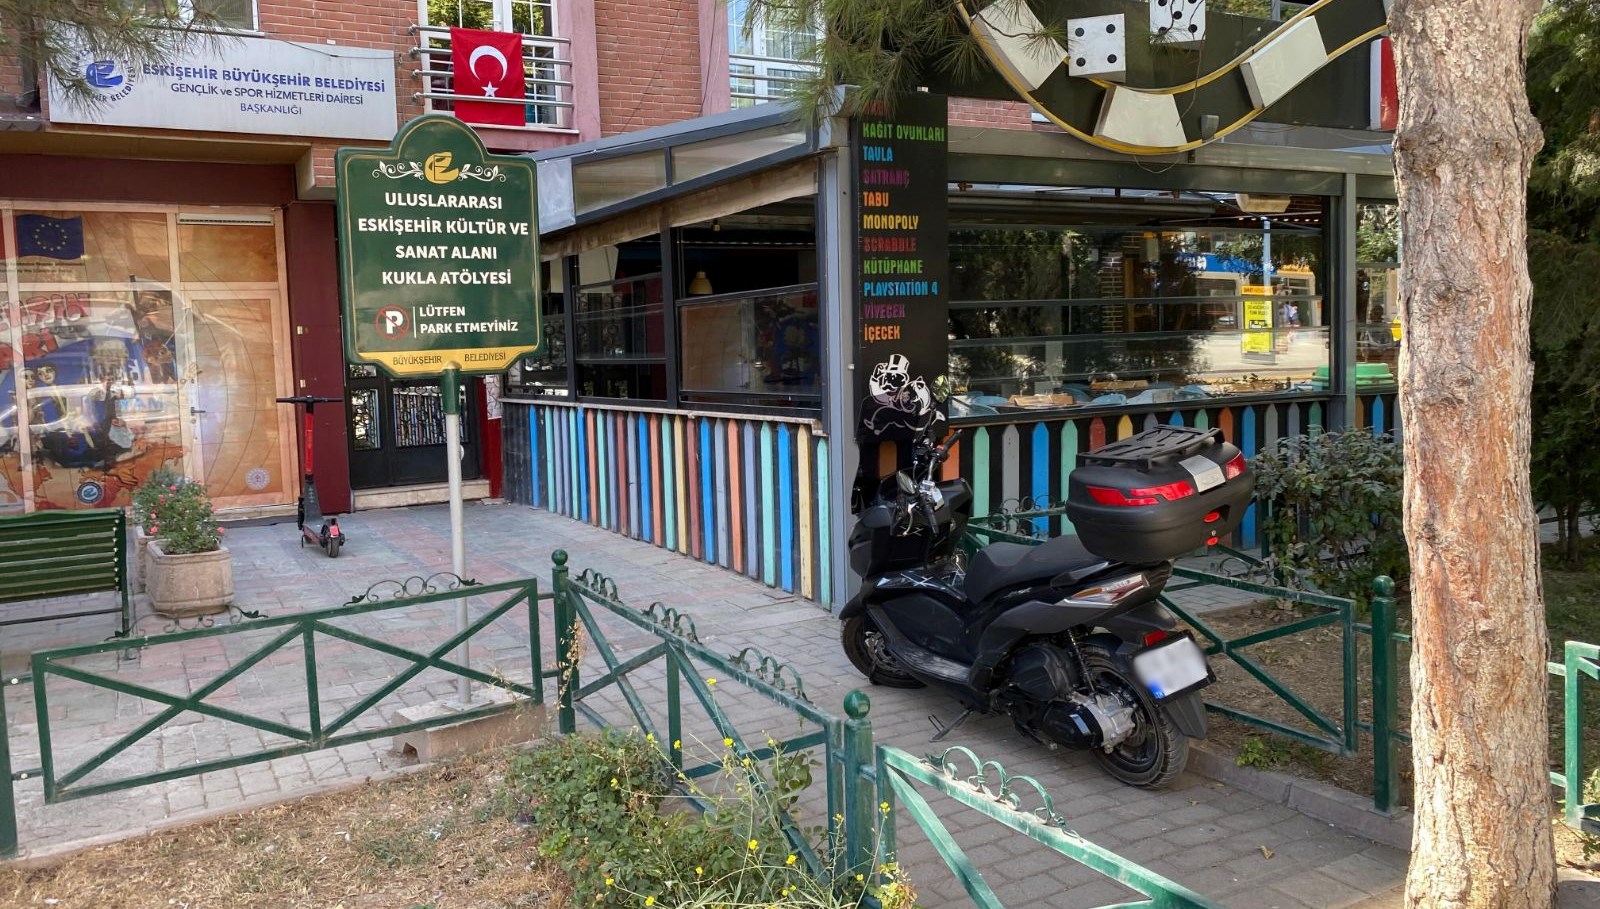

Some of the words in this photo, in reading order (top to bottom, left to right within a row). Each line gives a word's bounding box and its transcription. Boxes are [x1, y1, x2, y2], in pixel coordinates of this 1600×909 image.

[143, 63, 218, 80] ESKİŞEHİR
[222, 68, 311, 87] BÜYÜKŞEHİR
[315, 77, 385, 92] BELEDİYESİ
[171, 83, 218, 96] GENÇLİK
[234, 88, 263, 98] SPOR
[265, 88, 324, 102] HİZMETLERİ
[326, 93, 363, 105] DAİRESİ
[240, 103, 302, 115] BAŞKANLIĞI
[863, 121, 893, 139] KAĞIT
[896, 124, 945, 142] OYUNLARI
[863, 146, 893, 162] TAVLA
[864, 169, 910, 189] SATRANÇ
[385, 192, 502, 209] ULUSLARARASI
[863, 192, 889, 207] TABU
[358, 216, 442, 235] ESKİŞEHİR
[446, 218, 506, 235] KÜLTÜR
[509, 223, 529, 235] VE
[863, 214, 919, 230] MONOPOLY
[395, 245, 448, 258] SANAT
[451, 246, 497, 259] ALANI
[863, 237, 917, 252] SCRABBLE
[863, 257, 923, 274] KÜTÜPHANE
[382, 271, 436, 284] KUKLA
[440, 269, 512, 285] ATÖLYESİ
[931, 281, 938, 296] 4
[419, 305, 466, 317] LÜTFEN
[420, 323, 453, 334] PARK
[455, 319, 519, 333] ETMEYİNİZ
[864, 324, 901, 344] İÇECEK
[392, 355, 442, 366] BÜYÜKŞEHİR
[464, 352, 506, 362] BELEDİYESİ
